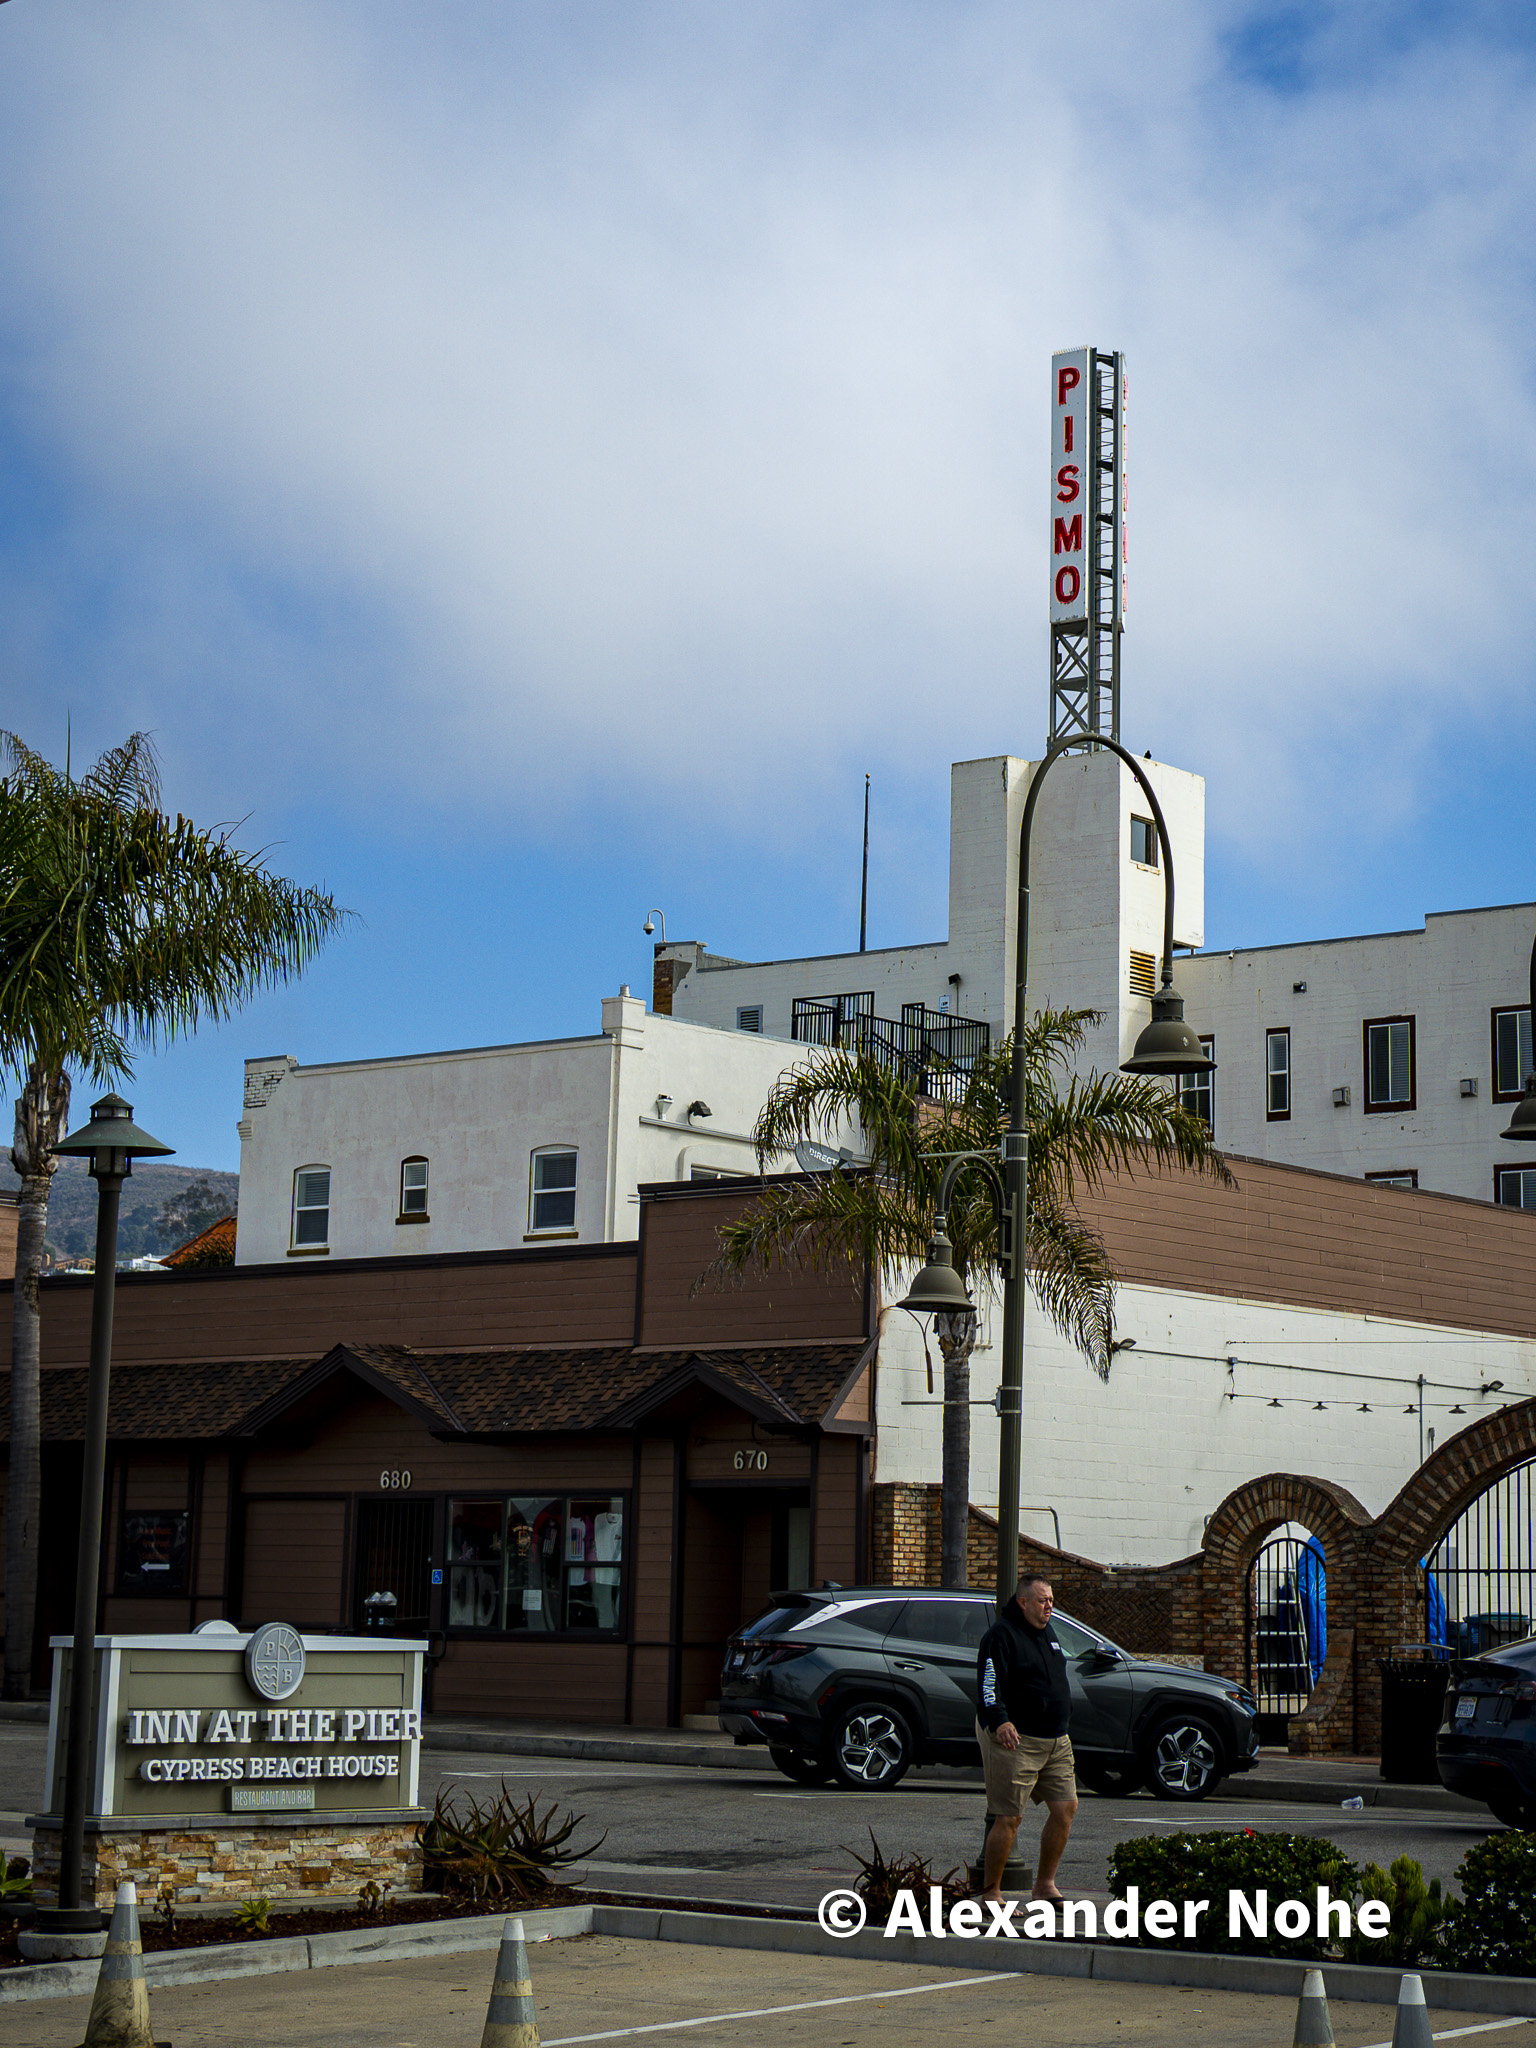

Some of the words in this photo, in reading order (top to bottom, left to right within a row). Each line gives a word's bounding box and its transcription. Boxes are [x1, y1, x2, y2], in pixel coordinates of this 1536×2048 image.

[1054, 367, 1082, 603] PISMO
[734, 1450, 767, 1470] 670
[380, 1470, 411, 1489] 680
[130, 1710, 201, 1744] INN
[209, 1710, 257, 1743] AT
[266, 1709, 336, 1742] THE
[343, 1708, 423, 1741] PIER
[146, 1758, 244, 1781] CYPRESS
[250, 1757, 322, 1779] BEACH
[328, 1755, 399, 1777] HOUSE
[235, 1790, 279, 1806] RESTAURANT
[281, 1790, 296, 1805] AND
[297, 1789, 312, 1804] BAR
